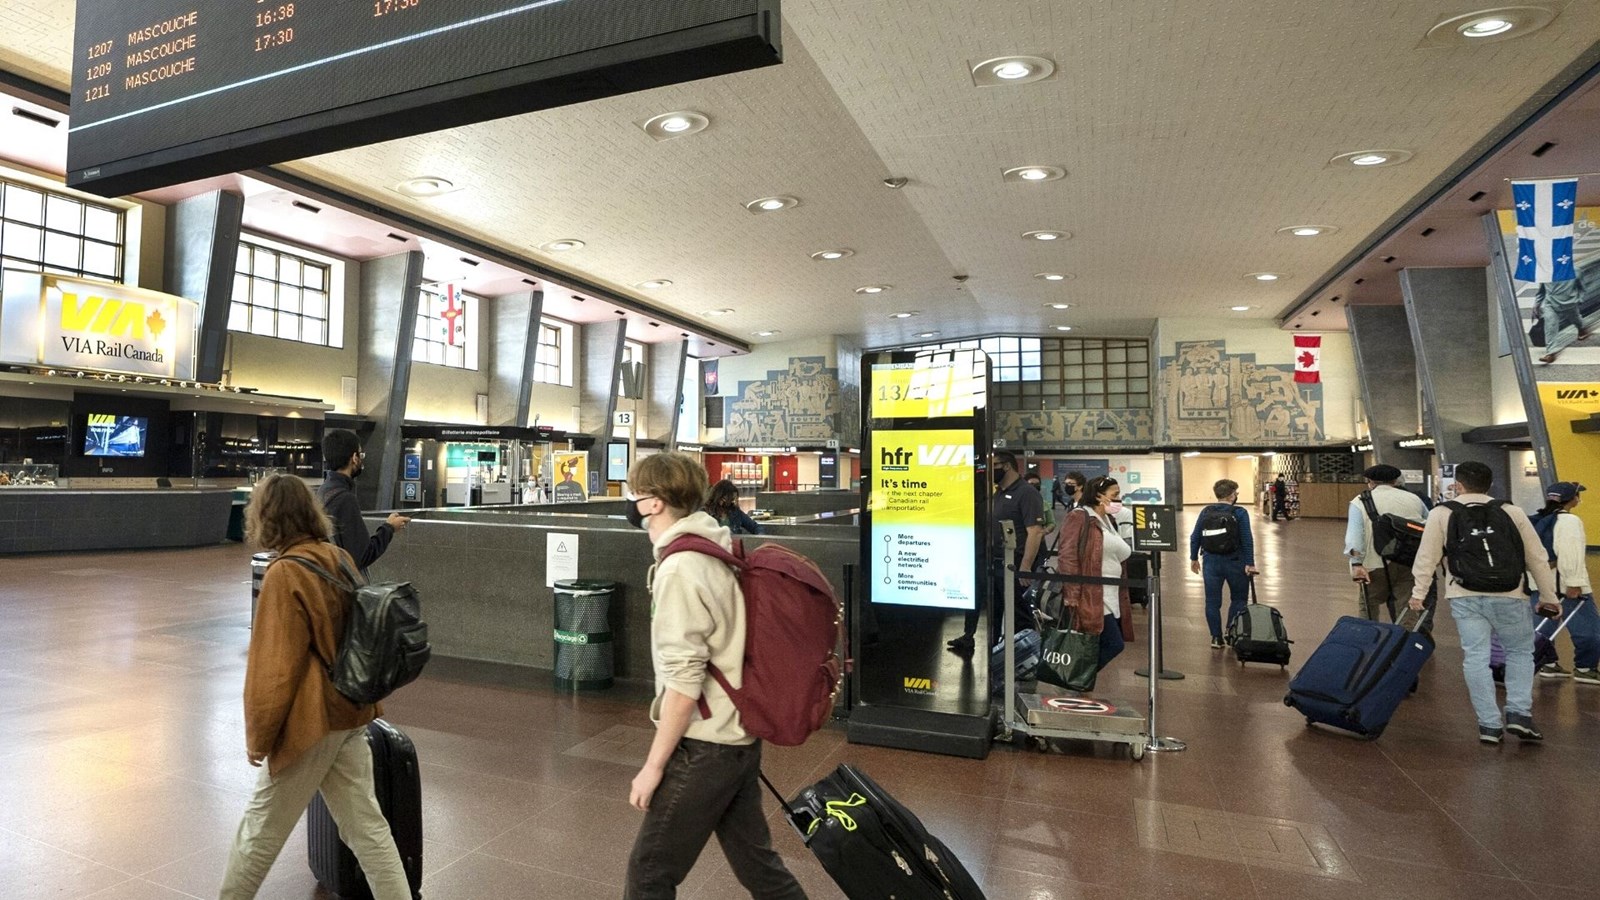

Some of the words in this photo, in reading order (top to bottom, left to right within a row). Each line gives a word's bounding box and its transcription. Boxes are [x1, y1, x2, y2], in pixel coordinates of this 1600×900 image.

[86, 62, 112, 81] 1209
[126, 34, 197, 68] MASCOUCHE
[255, 4, 295, 28] 16:38
[87, 40, 113, 60] 1207
[127, 11, 198, 46] MASCOUCHE
[85, 83, 110, 102] 1211
[125, 57, 196, 90] MASCOUCHE
[254, 28, 294, 52] 17:30
[61, 292, 145, 340] VIA
[61, 335, 92, 354] VIA
[96, 340, 122, 357] Rail
[124, 343, 164, 363] Canada
[1556, 389, 1588, 399] VIA
[618, 413, 631, 424] 13
[881, 447, 913, 465] hfr
[881, 479, 899, 489] It's
[901, 480, 928, 489] time
[1130, 474, 1138, 482] P
[918, 491, 944, 499] chapter
[904, 676, 931, 690] VIA
